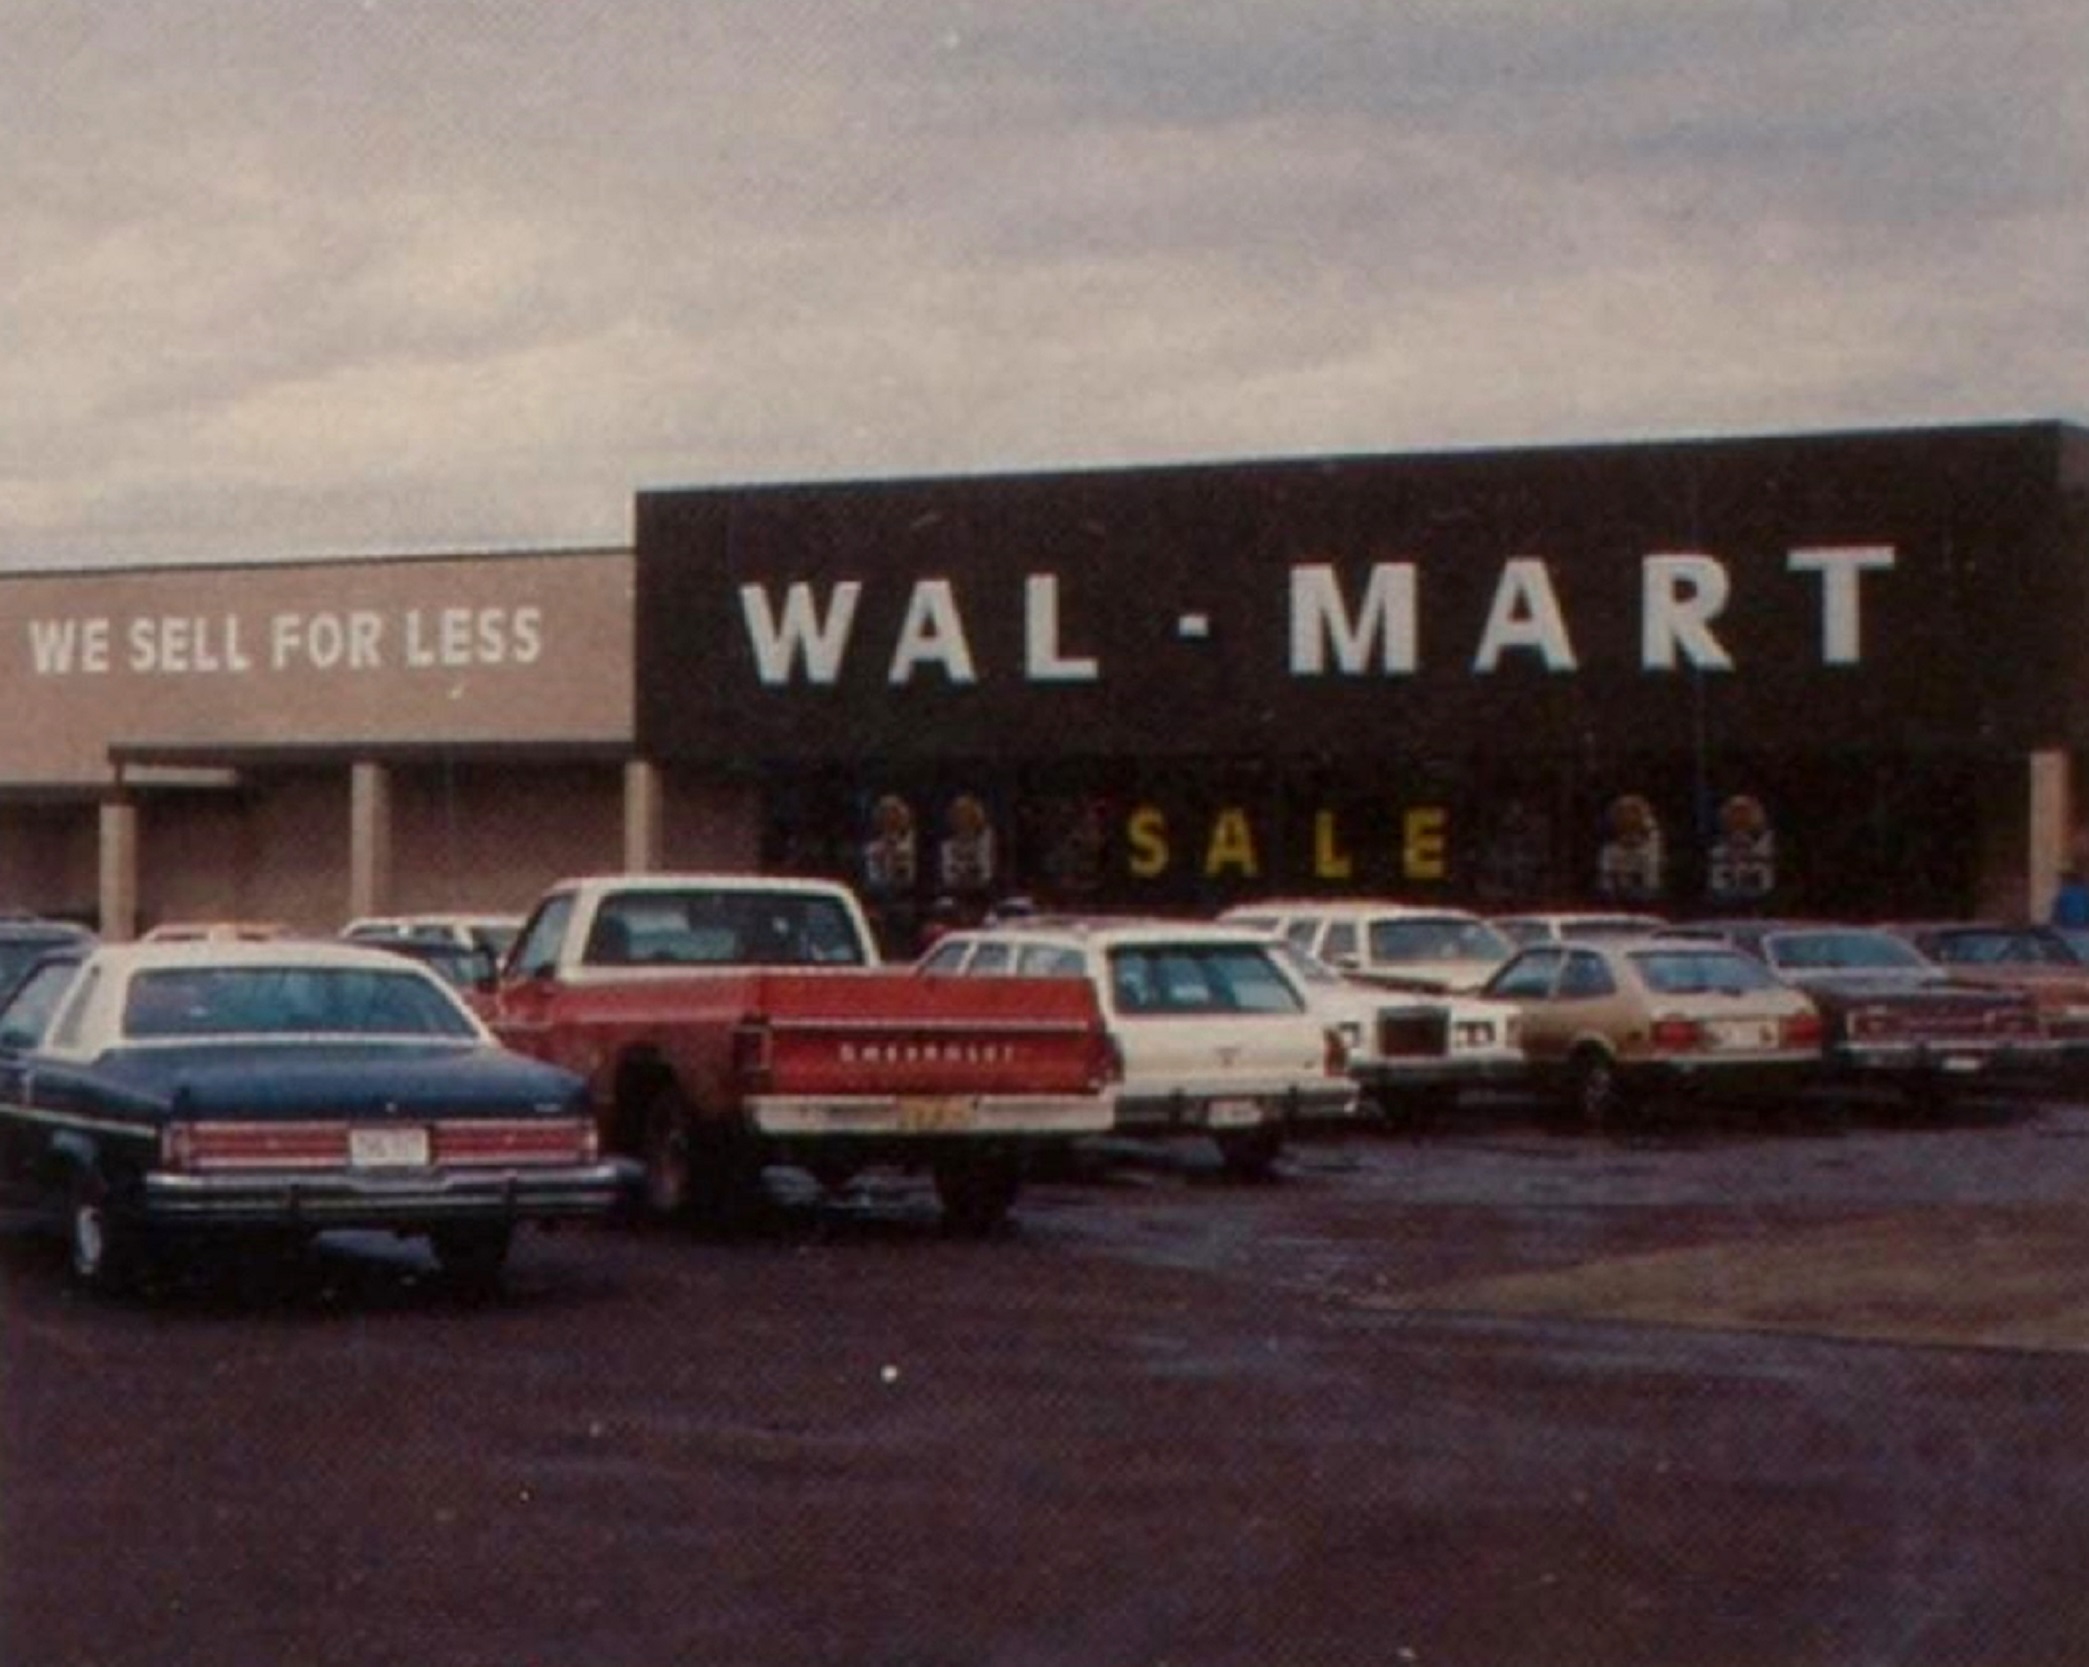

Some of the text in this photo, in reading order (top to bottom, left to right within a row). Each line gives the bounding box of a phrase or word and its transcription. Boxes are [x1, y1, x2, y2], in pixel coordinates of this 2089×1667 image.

[28, 605, 542, 675] WE SELL FOR LESS
[740, 573, 1098, 683] WAL
[1289, 545, 1896, 674] MART
[1127, 807, 1446, 879] SALE
